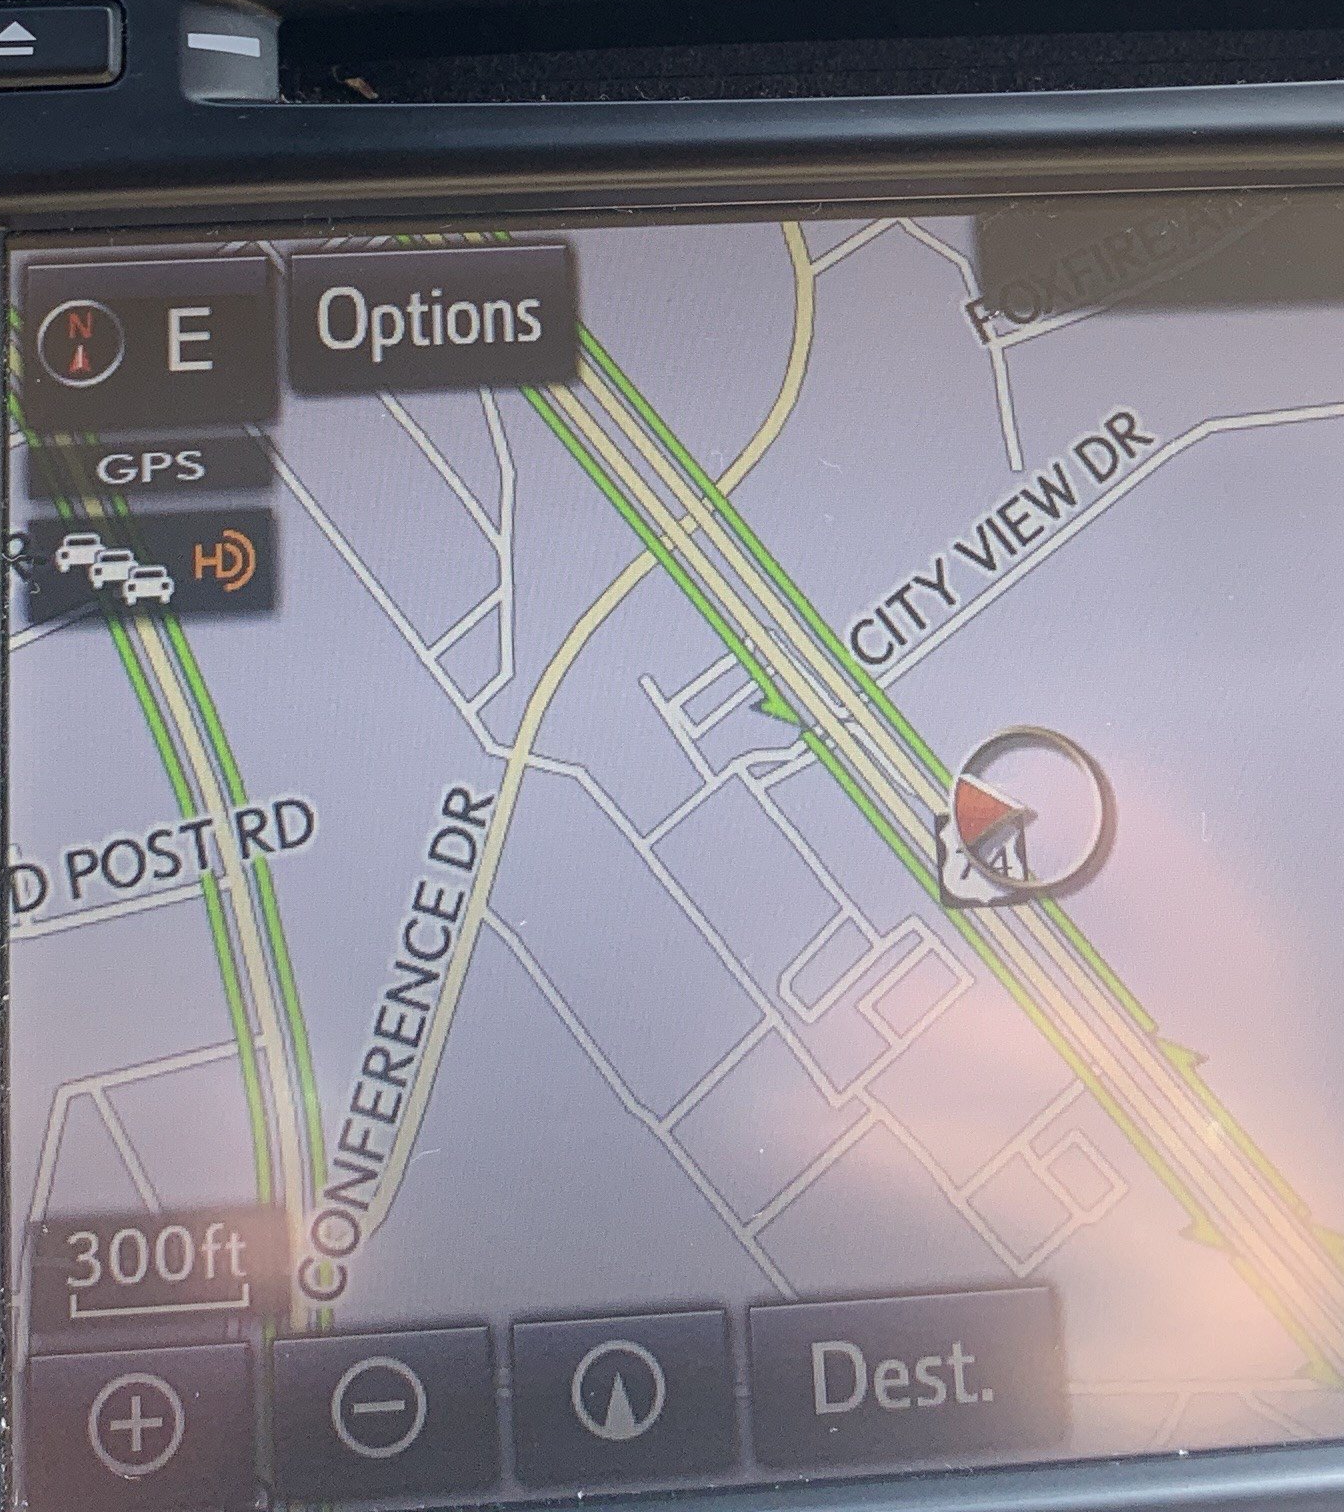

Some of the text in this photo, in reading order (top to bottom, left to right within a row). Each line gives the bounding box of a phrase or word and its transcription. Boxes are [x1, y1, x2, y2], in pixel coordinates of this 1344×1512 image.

[68, 311, 93, 339] N
[166, 306, 214, 373] E
[317, 285, 542, 363] Options
[96, 449, 206, 484] GPS
[849, 409, 1154, 667] CITY VIEW DR
[67, 817, 213, 901] POST
[236, 799, 316, 859] RD
[298, 785, 496, 1303] CONFERENCE DR
[67, 1222, 248, 1287] 300ft
[812, 1338, 995, 1415] Dest.
